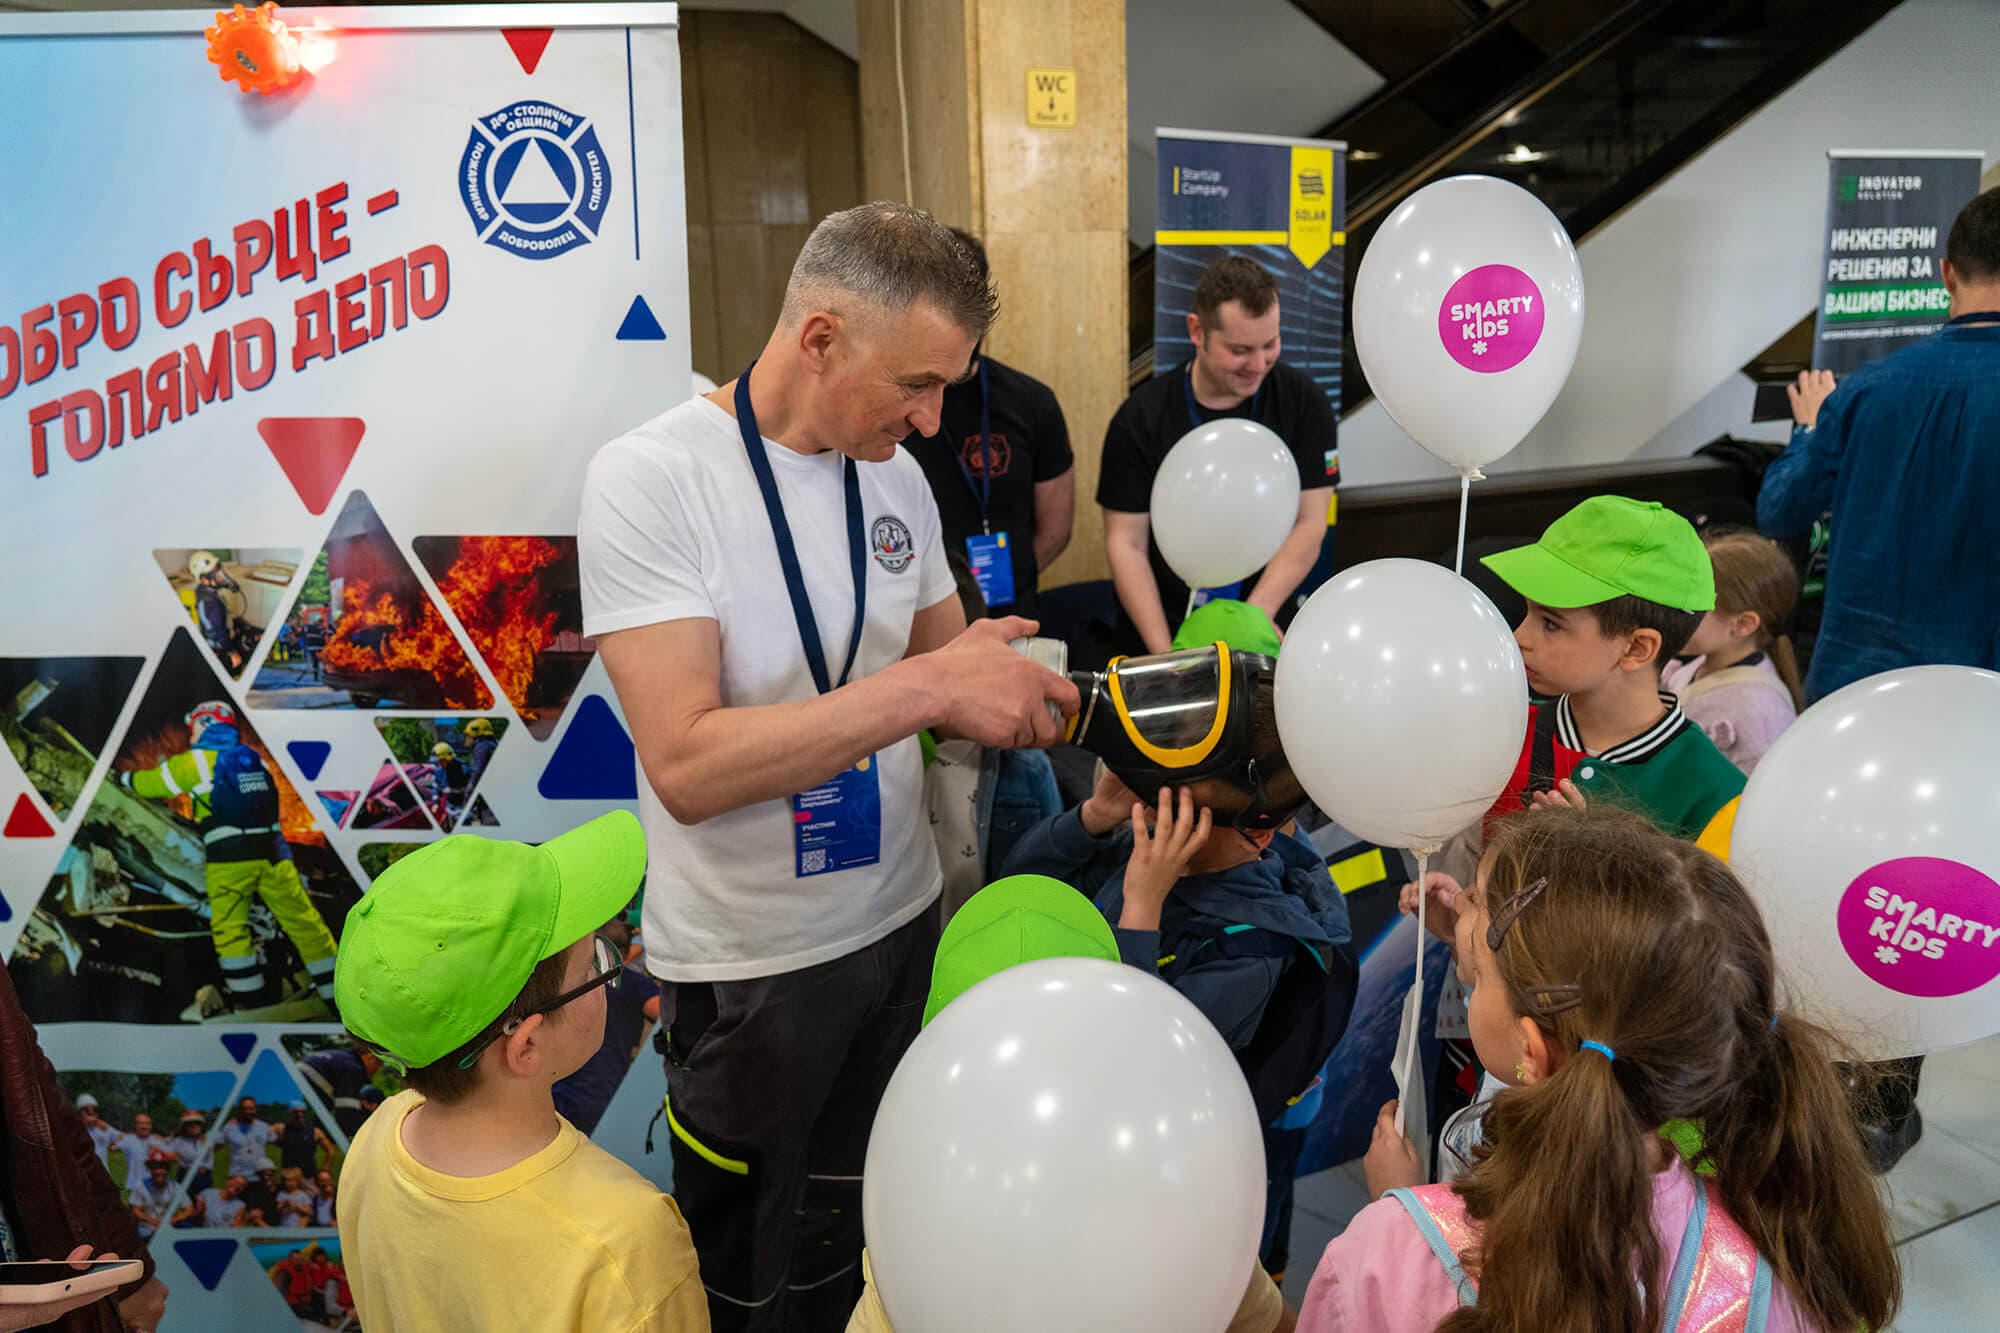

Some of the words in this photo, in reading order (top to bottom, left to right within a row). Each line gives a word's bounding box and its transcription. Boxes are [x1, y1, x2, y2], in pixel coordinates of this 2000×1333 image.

[1035, 75, 1067, 94] WC
[506, 117, 559, 131] ОБЩИНА
[514, 106, 573, 127] СТОЛИЧНА
[467, 141, 490, 222] ПОЖАРНИКАР
[586, 150, 603, 212] СПАСИТЕЛ
[1181, 181, 1230, 199] Company
[1858, 176, 1923, 191] INOVATOR
[498, 230, 577, 251] ДОБРОВОЛЕЦ
[1830, 226, 1937, 251] ИНЖЕНЕРНИ
[154, 181, 350, 330] СЪРЦЕ
[1828, 257, 1906, 281] РЕШЕНИЯ
[1910, 256, 1932, 278] ЗА
[1451, 295, 1533, 322] SMARTY
[1825, 291, 1886, 315] ВАШИЯ
[1888, 288, 1950, 312] БИЗНЕС
[1462, 318, 1509, 340] KIDS
[28, 317, 277, 479] ГОЛЯМО
[292, 244, 450, 374] ДЕЛО
[1864, 886, 2000, 948] SMARTY
[1868, 916, 1948, 960] KIDS
